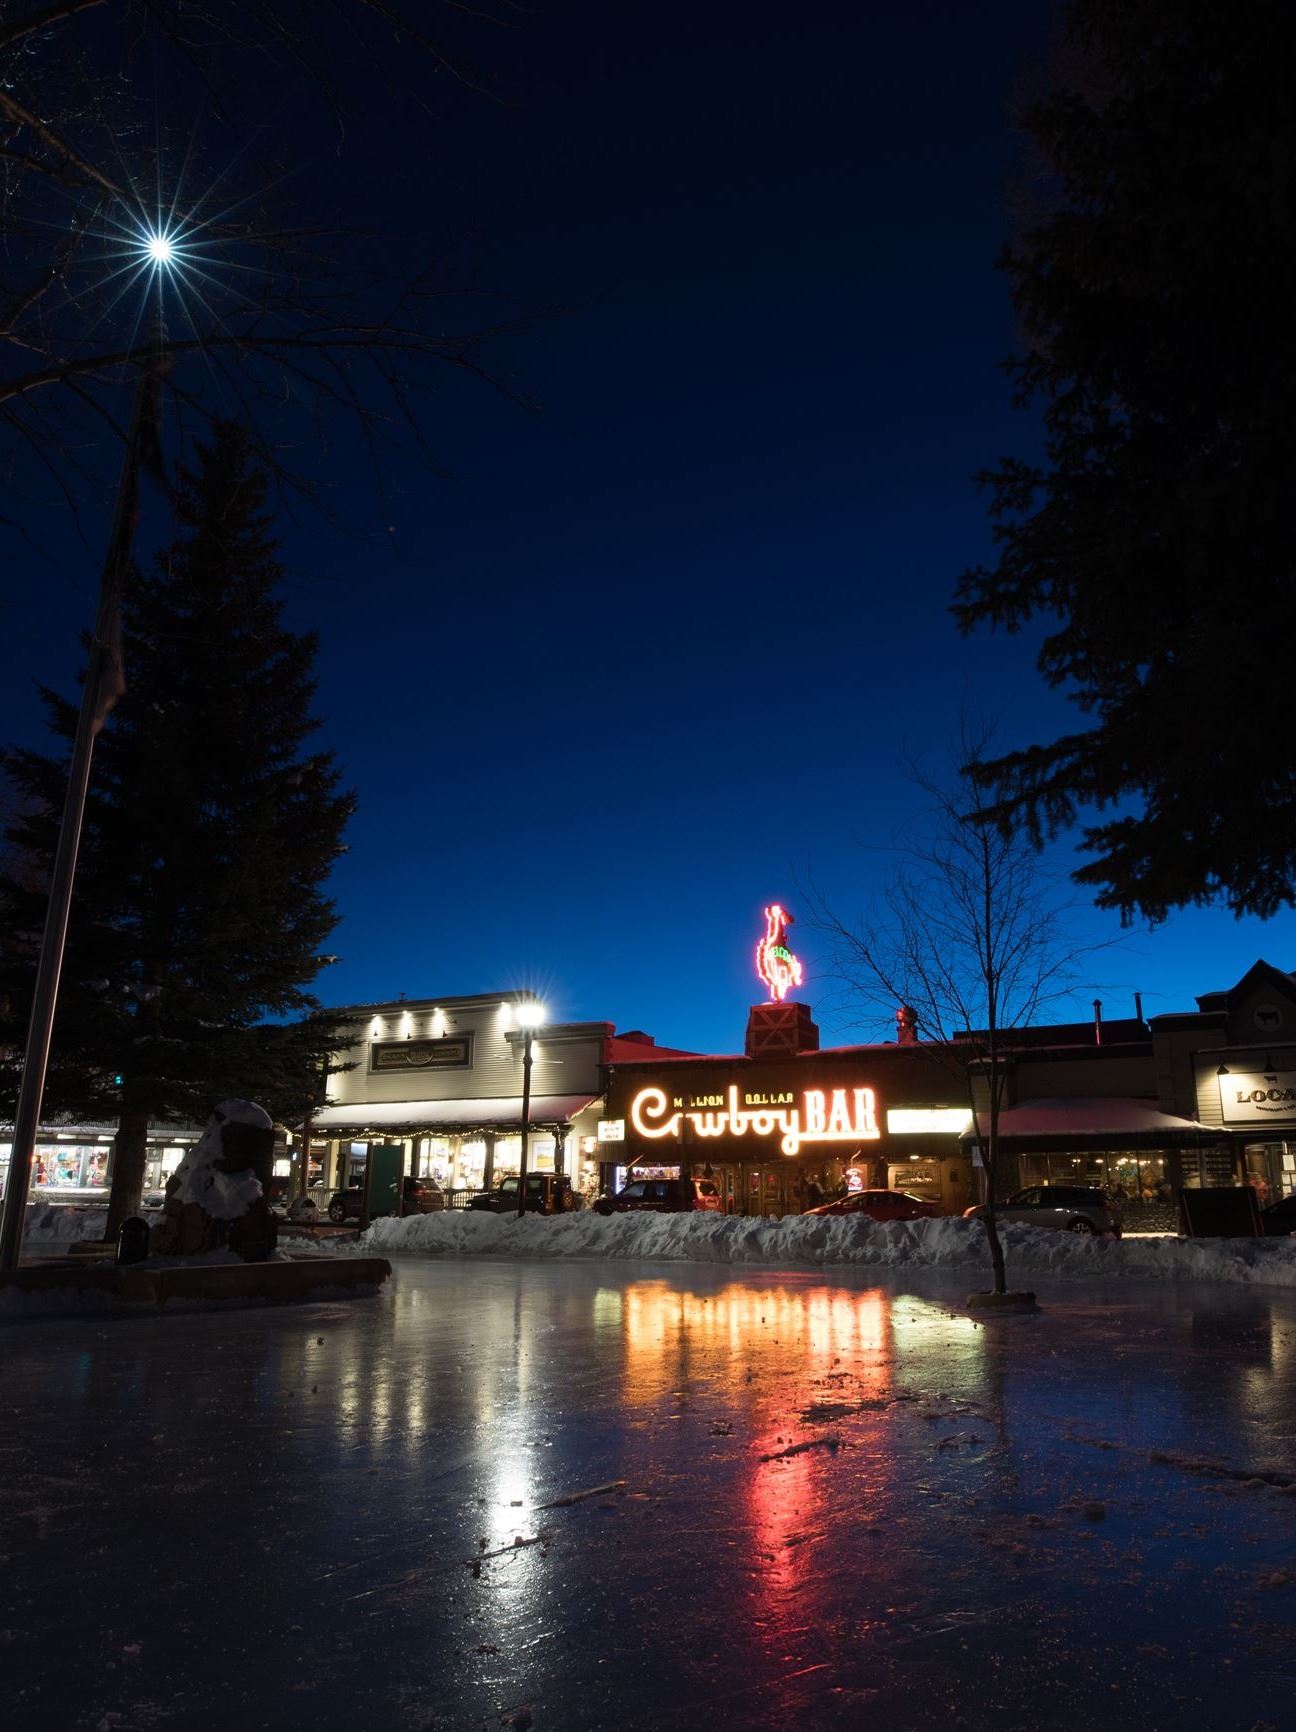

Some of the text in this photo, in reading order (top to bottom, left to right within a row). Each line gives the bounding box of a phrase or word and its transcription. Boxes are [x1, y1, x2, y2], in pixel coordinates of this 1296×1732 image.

[673, 1092, 793, 1107] MLLION DOLLAR
[804, 1087, 879, 1134] BAR
